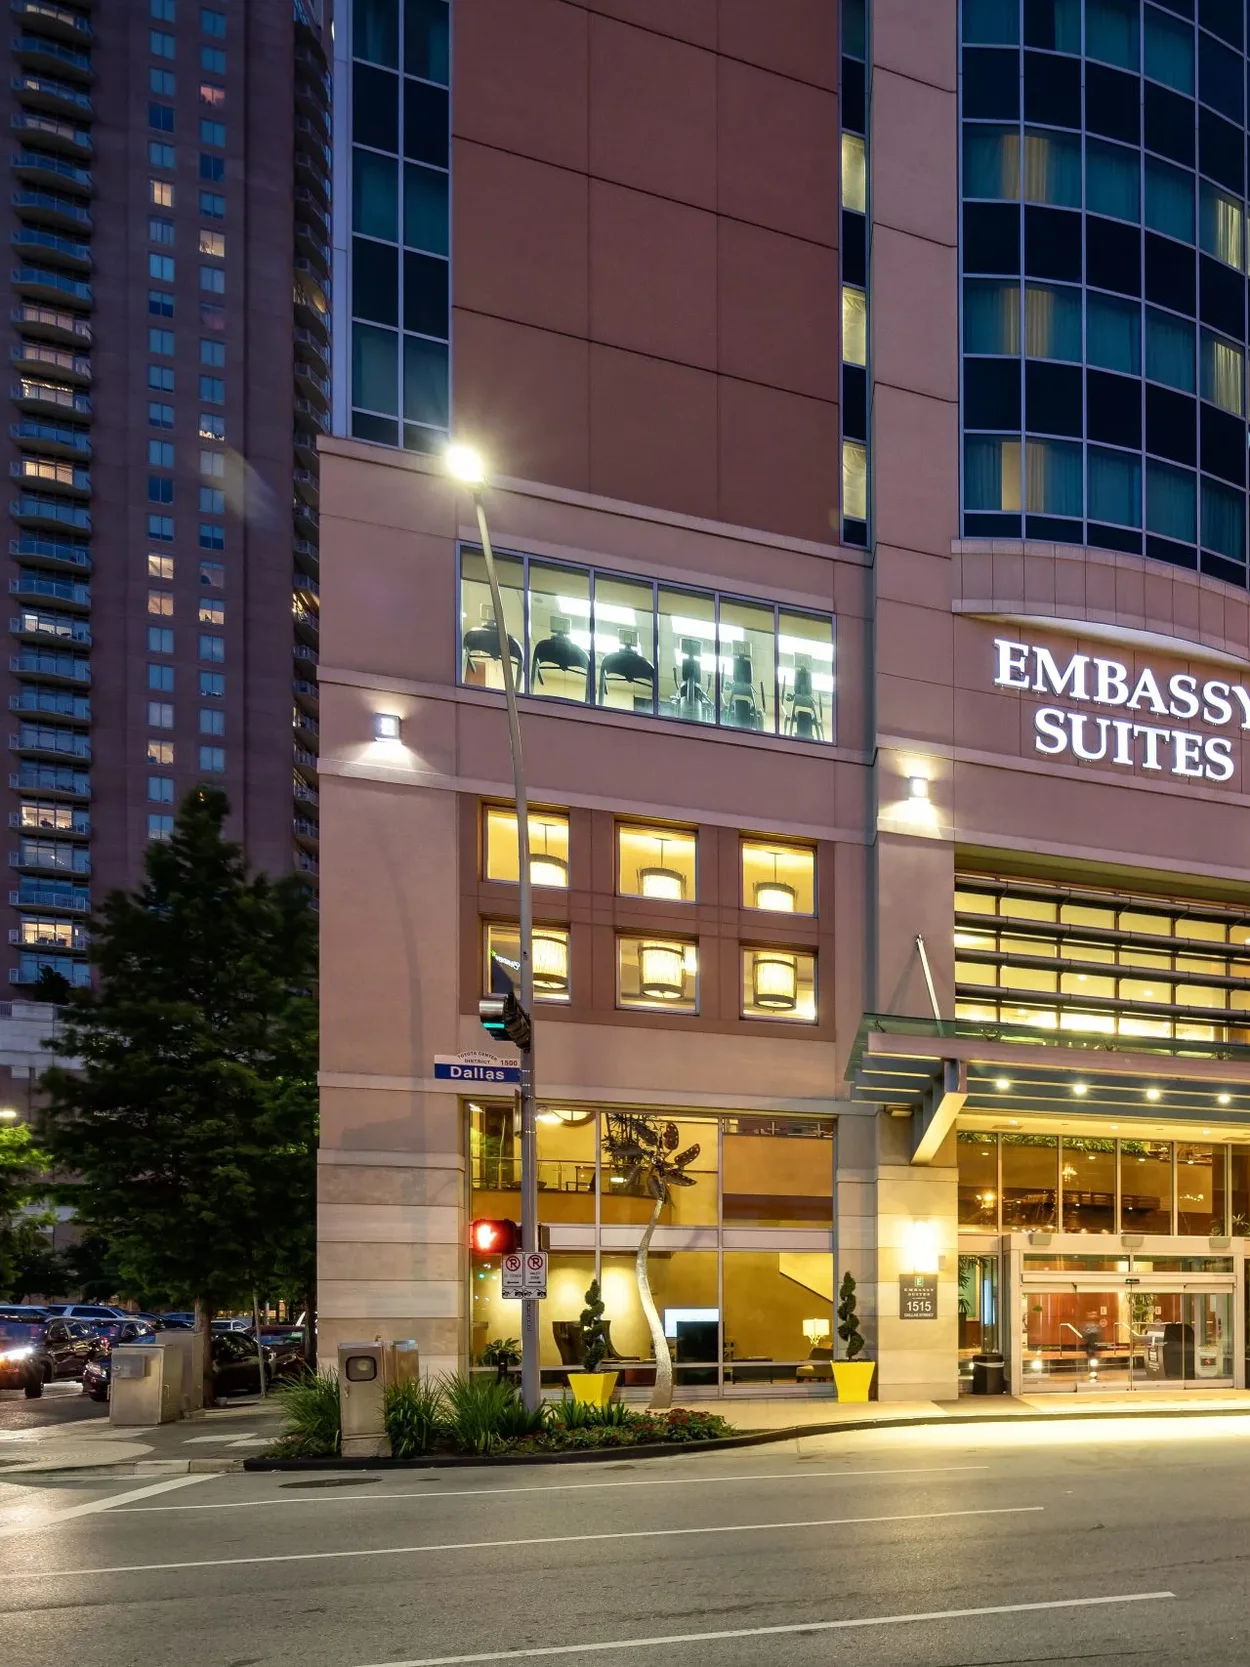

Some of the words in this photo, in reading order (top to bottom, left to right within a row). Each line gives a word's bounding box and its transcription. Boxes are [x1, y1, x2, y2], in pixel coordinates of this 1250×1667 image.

[1033, 707, 1236, 782] SUITES
[457, 1051, 477, 1059] TOYOTA
[478, 1051, 498, 1061] CENTER
[450, 1066, 505, 1080] Dallas
[907, 1301, 932, 1312] 1515
